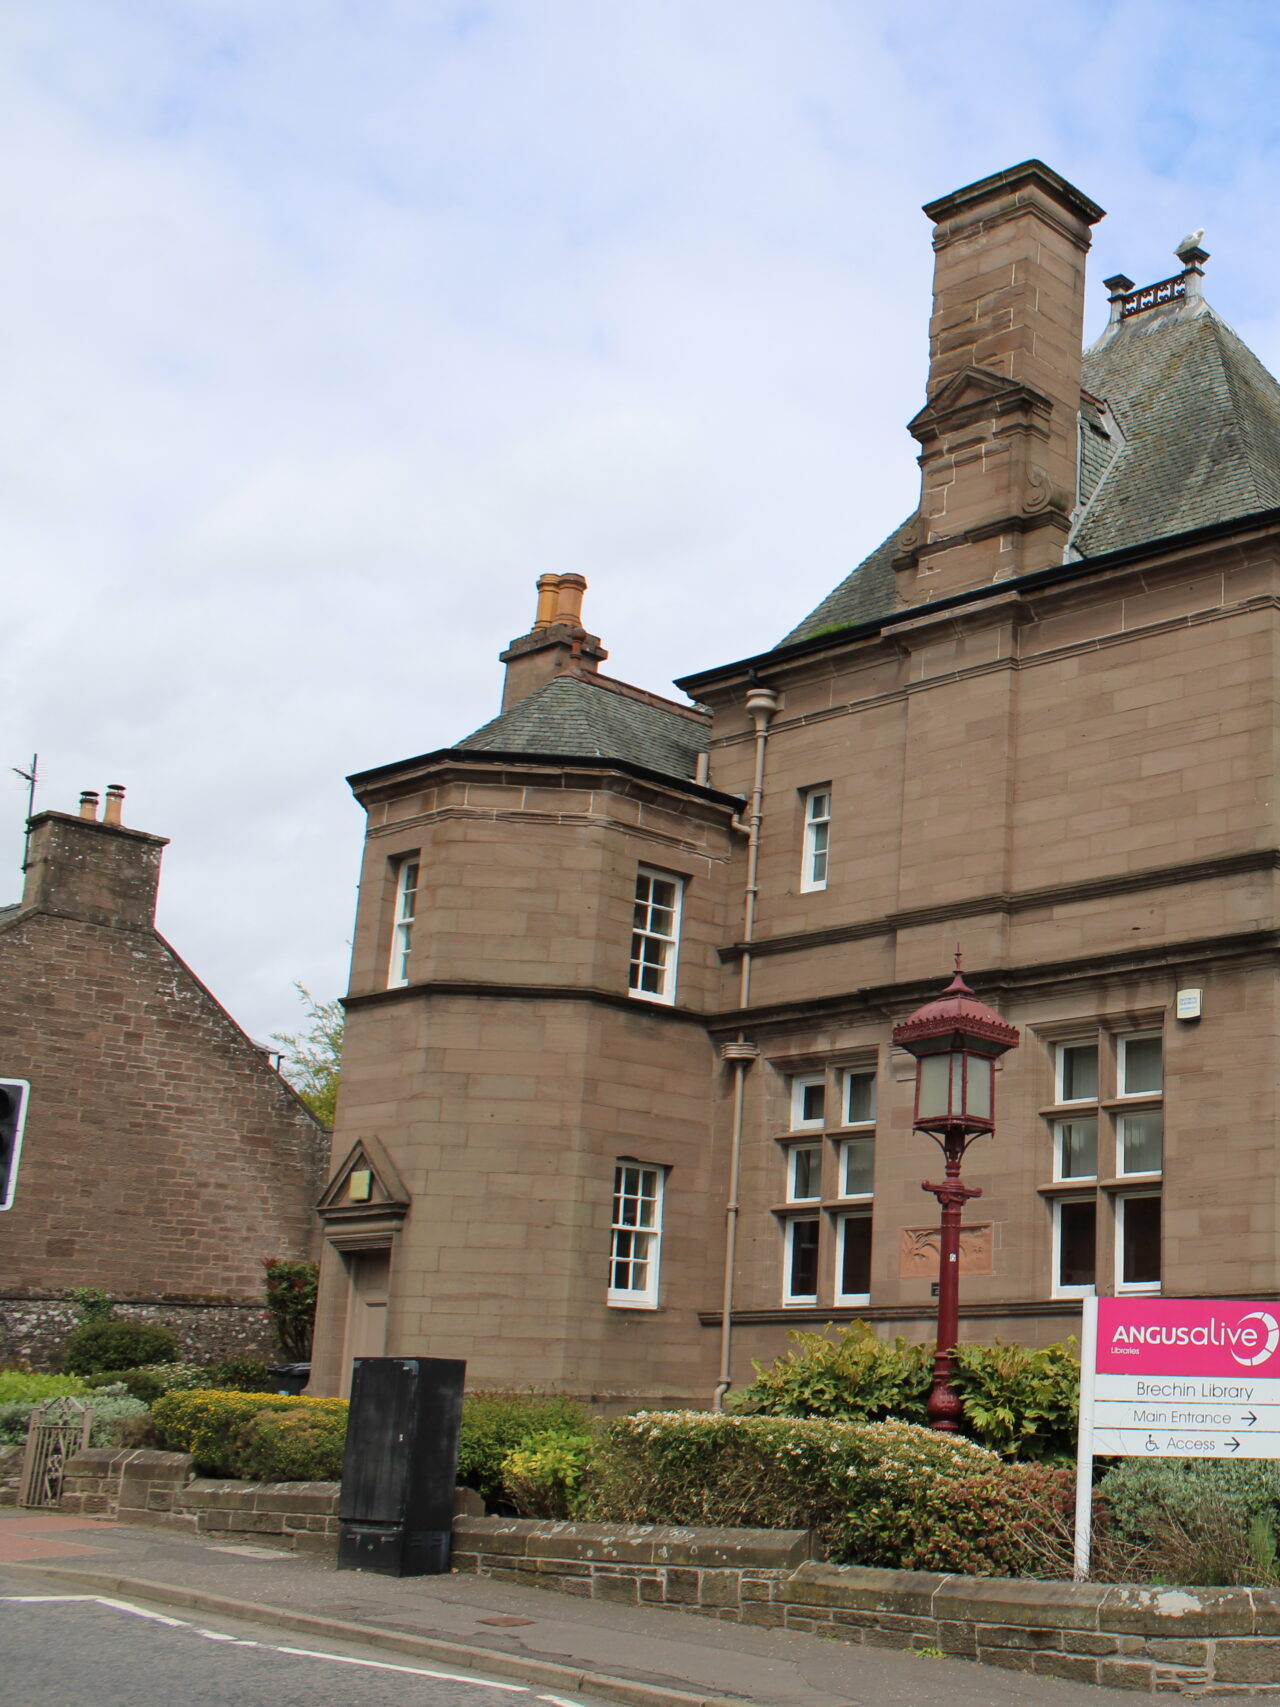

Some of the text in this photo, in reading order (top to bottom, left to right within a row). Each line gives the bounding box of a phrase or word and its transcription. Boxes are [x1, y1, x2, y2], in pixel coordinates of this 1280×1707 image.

[1110, 1346, 1140, 1355] Libraries
[1136, 1381, 1254, 1401] Brechin Library
[1133, 1409, 1232, 1425] Main Entrance
[1166, 1437, 1216, 1451] Access
